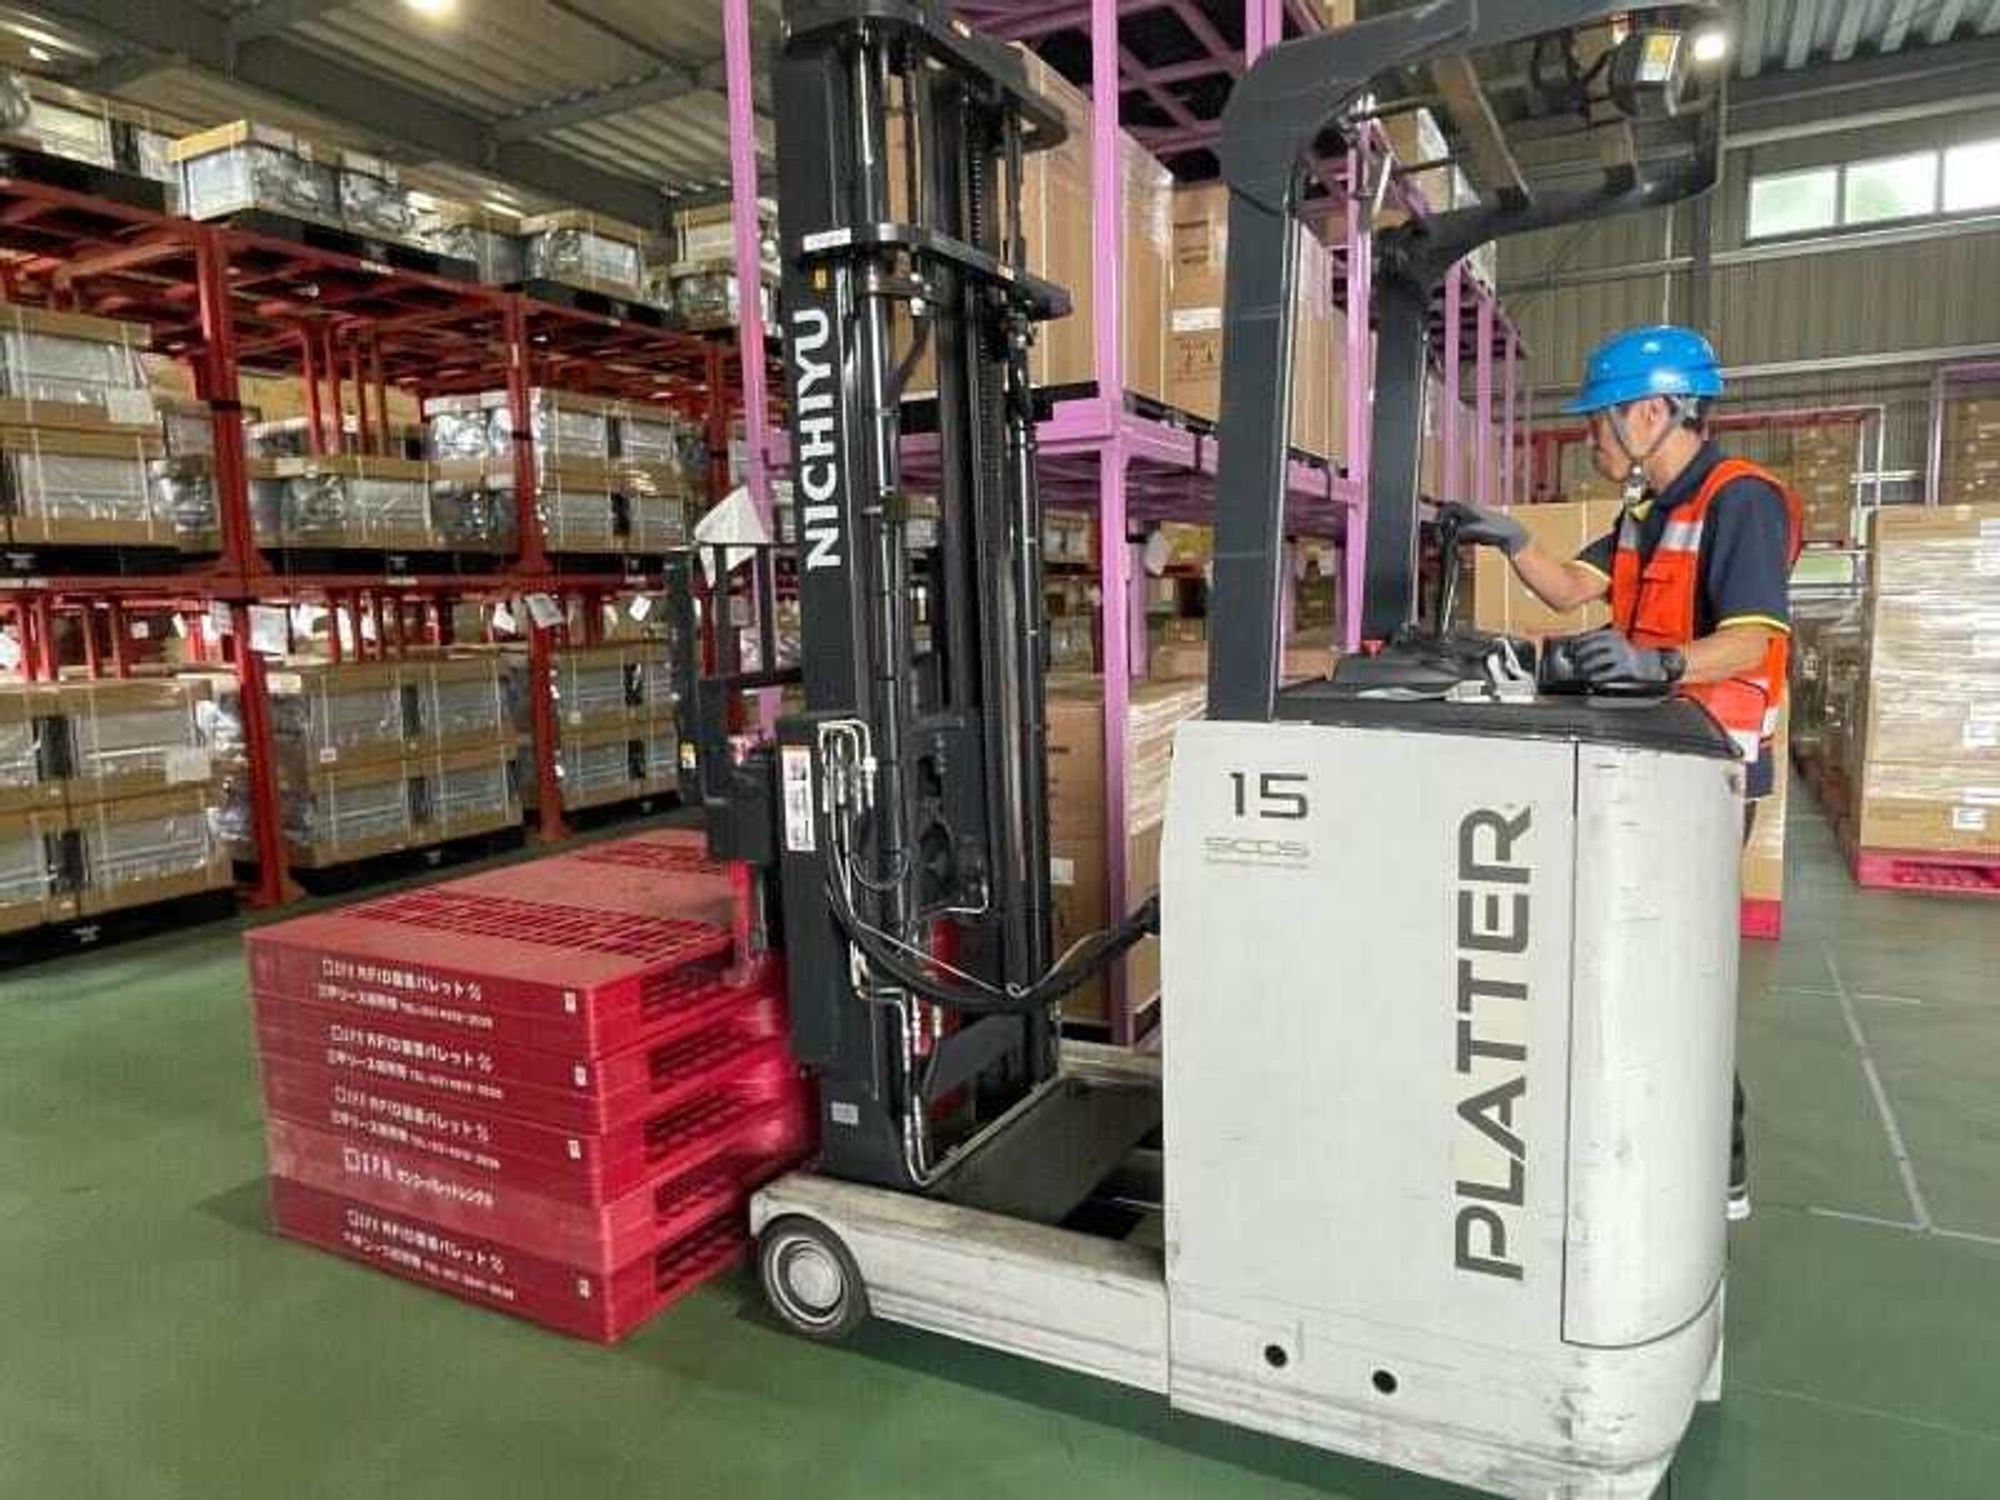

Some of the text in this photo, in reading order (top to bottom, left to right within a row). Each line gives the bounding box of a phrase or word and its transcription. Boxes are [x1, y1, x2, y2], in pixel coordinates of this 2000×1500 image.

[793, 309, 841, 571] NICHIYU
[1229, 772, 1309, 819] 15
[1455, 804, 1532, 1281] PLATTER
